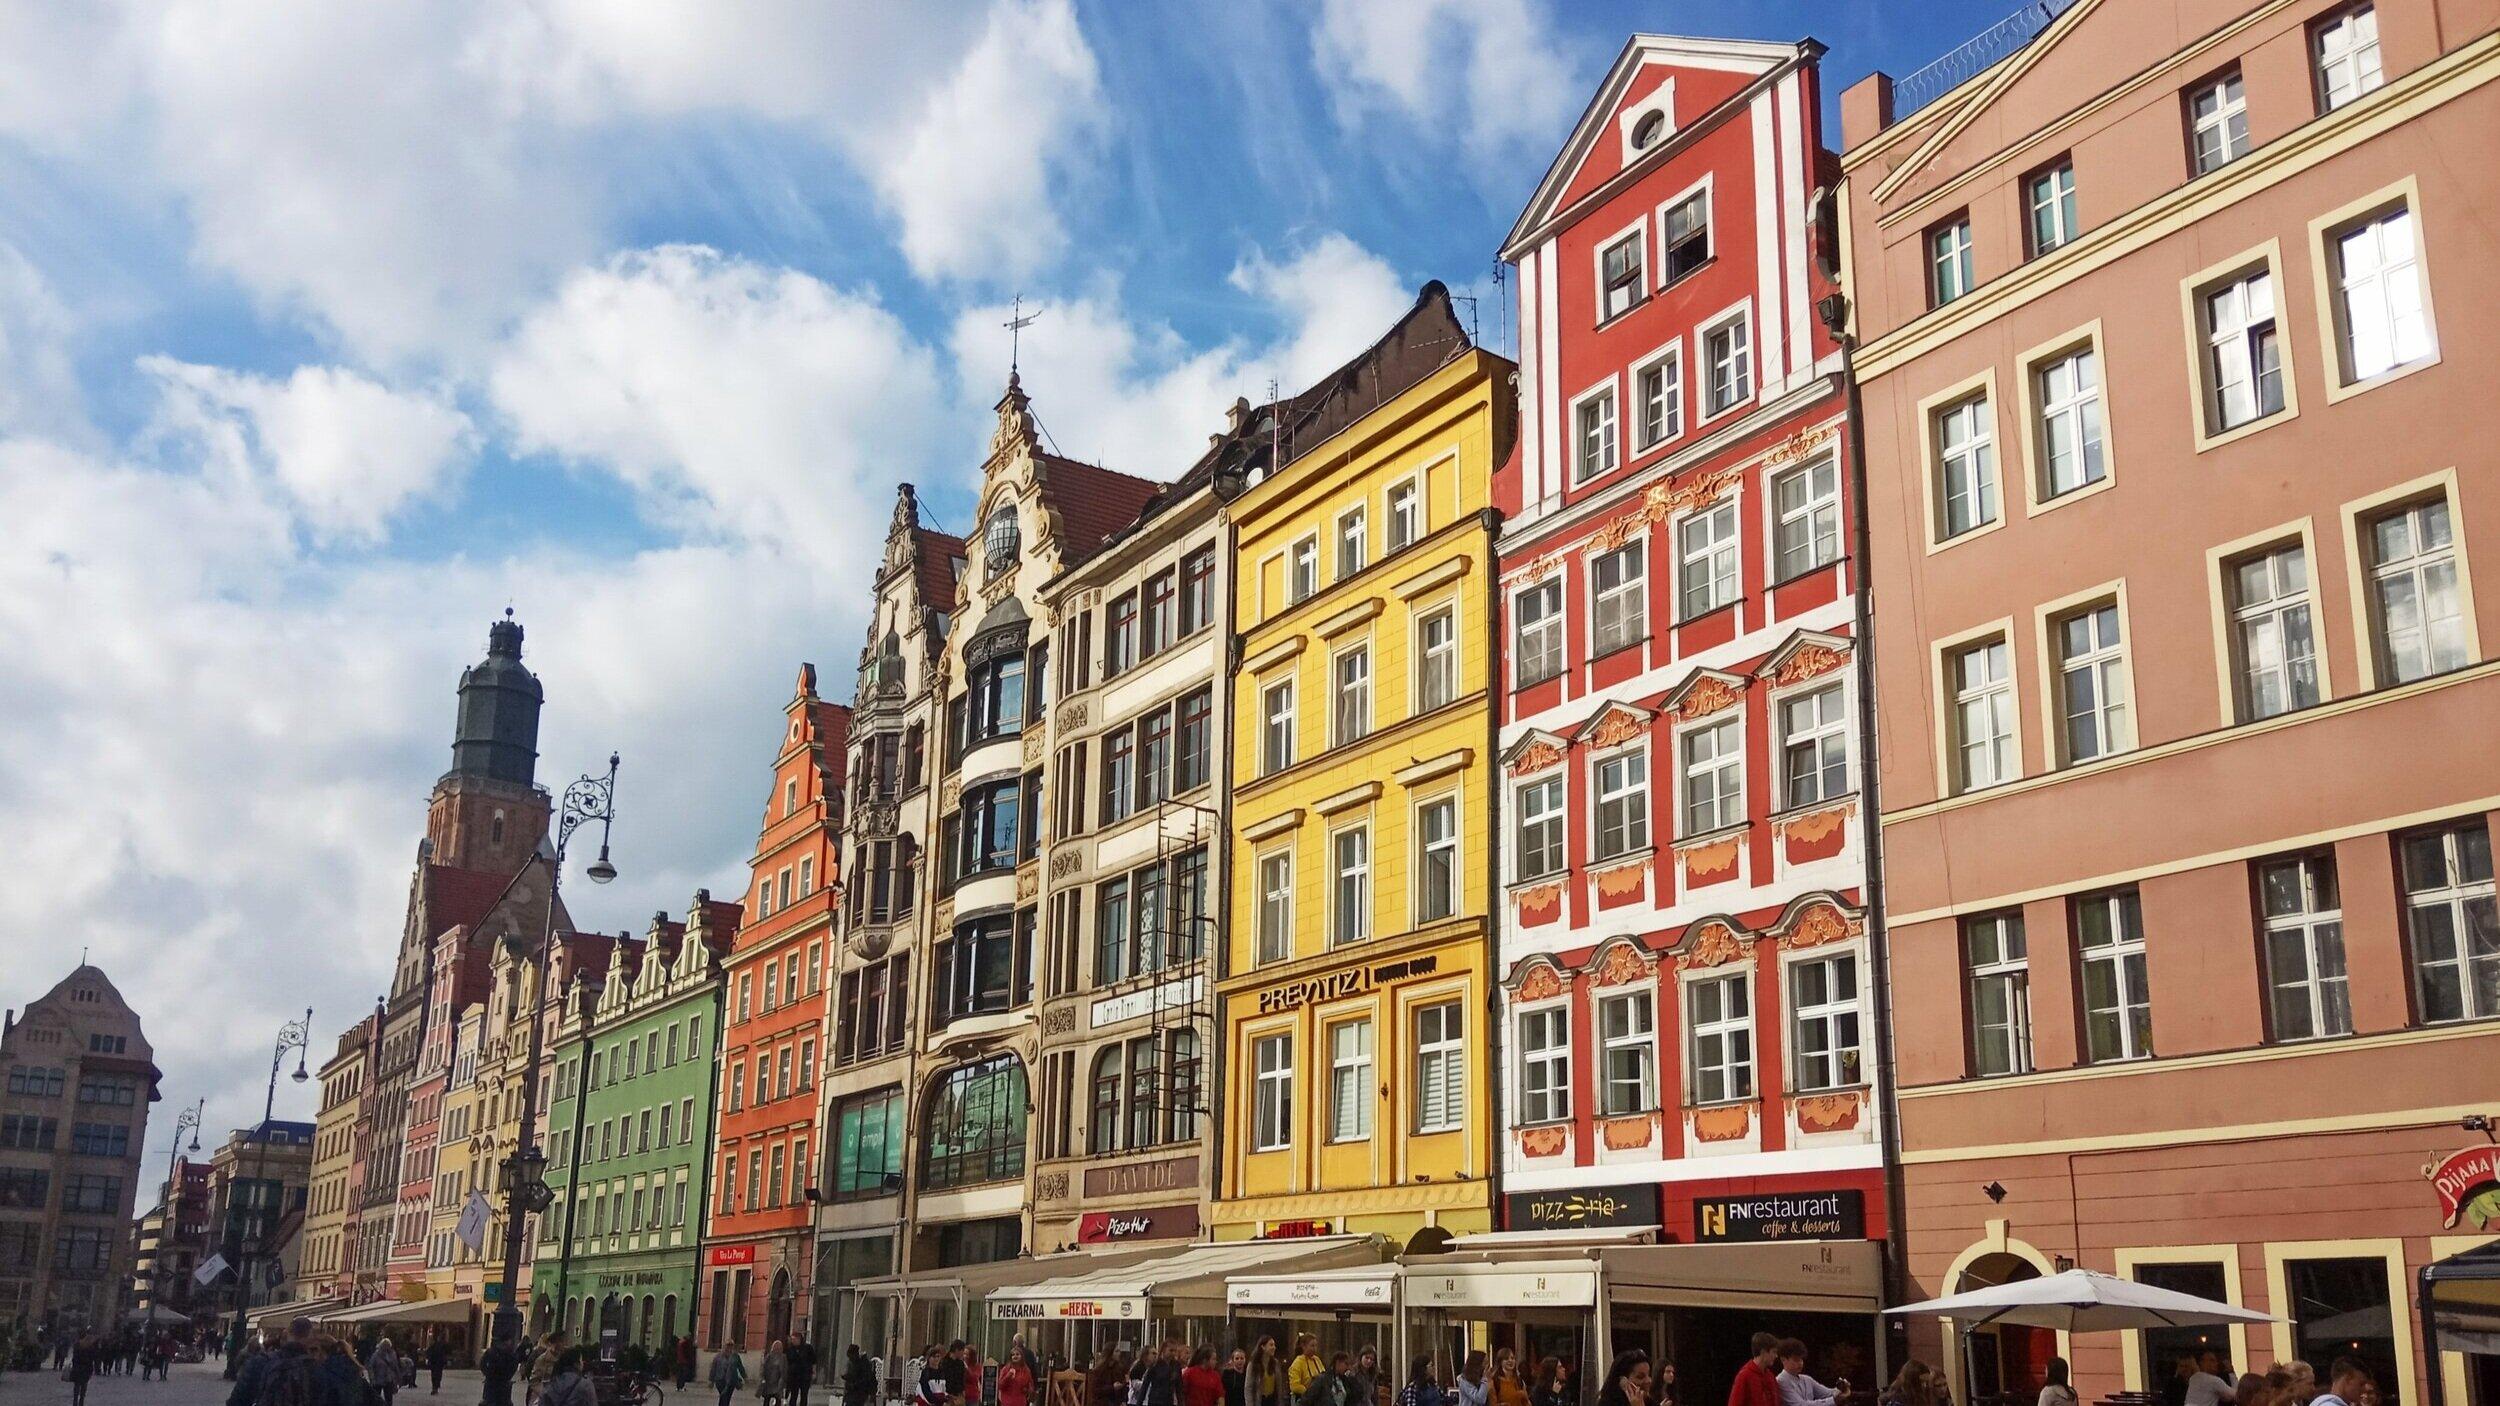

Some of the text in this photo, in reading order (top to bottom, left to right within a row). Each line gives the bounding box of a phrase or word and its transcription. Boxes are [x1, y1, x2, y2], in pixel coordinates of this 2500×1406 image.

[1107, 1162, 1176, 1192] DAVIDE
[1729, 1193, 1840, 1220] FNrestaurant
[1106, 1216, 1151, 1237] Pizza Hut
[1279, 1221, 1313, 1237] HERT
[1761, 1218, 1841, 1238] coffee & desserts
[998, 1301, 1094, 1318] PIEKARNIA HERT
